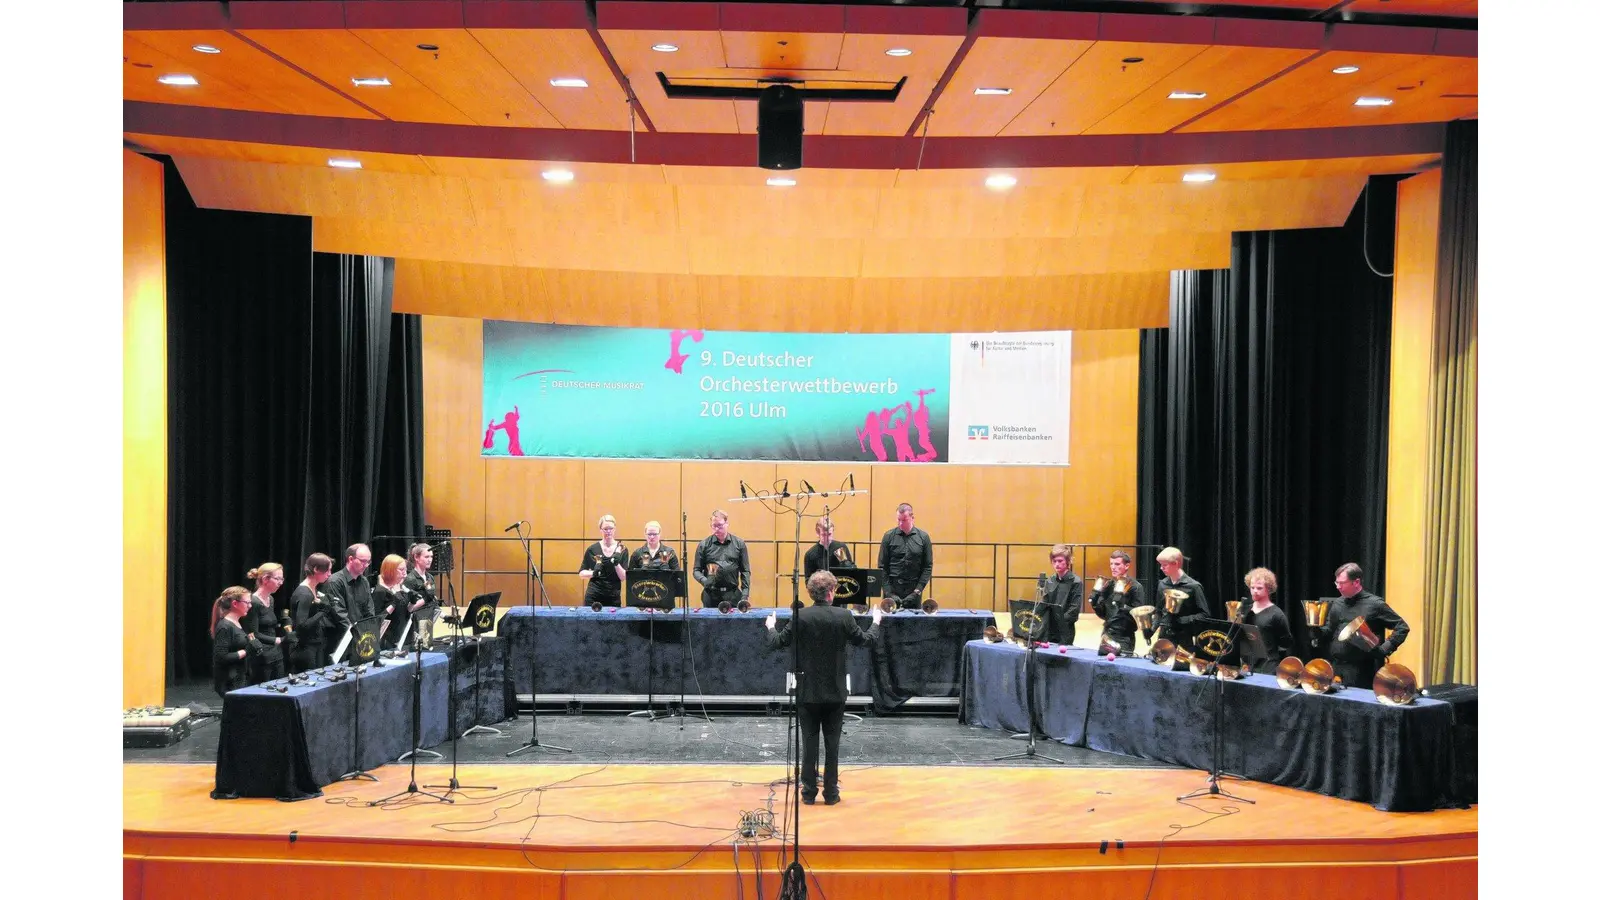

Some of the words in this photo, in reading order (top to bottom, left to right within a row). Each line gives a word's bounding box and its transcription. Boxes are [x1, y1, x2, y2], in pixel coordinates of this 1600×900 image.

[700, 350, 717, 366] 9.
[722, 350, 814, 368] Deutscher
[551, 380, 601, 389] DEUTSCHER
[603, 381, 645, 390] MUSIKRAT
[700, 375, 898, 394] Orchesterwettbewerb
[700, 401, 744, 418] 2016
[749, 402, 786, 418] Ulm
[992, 425, 1037, 433] Volksbanken
[992, 433, 1053, 441] Raiffeisenbanken
